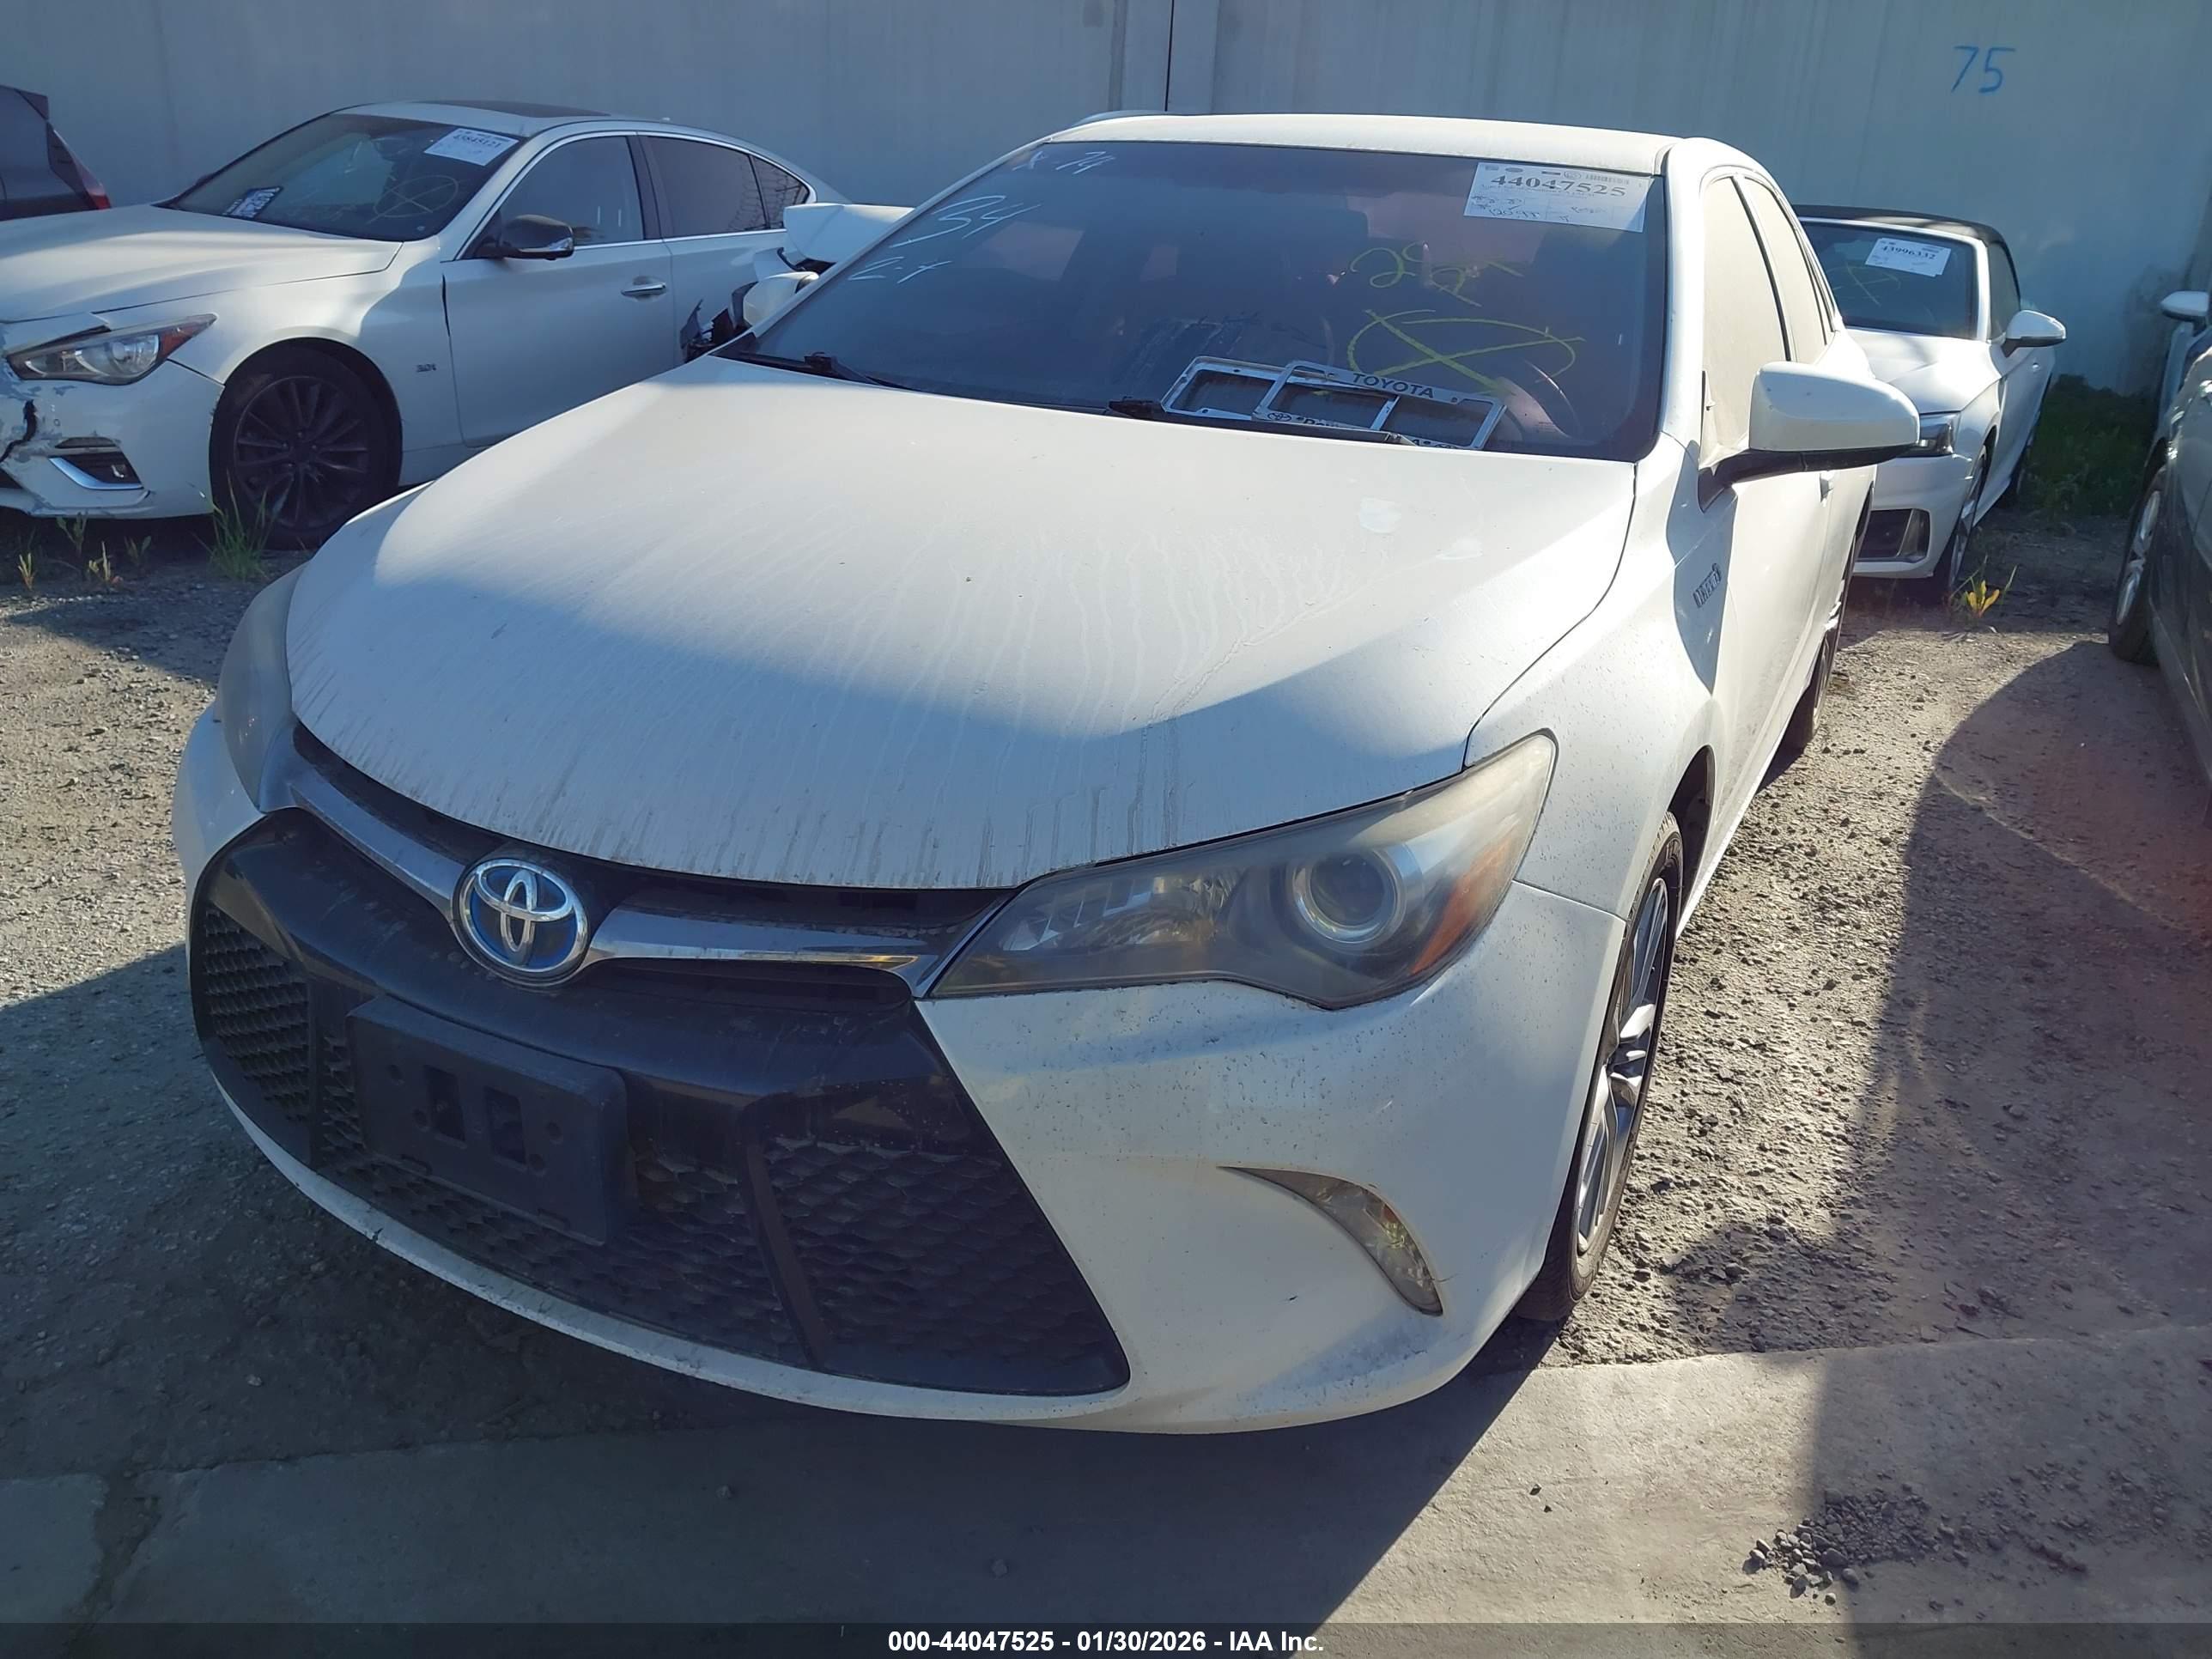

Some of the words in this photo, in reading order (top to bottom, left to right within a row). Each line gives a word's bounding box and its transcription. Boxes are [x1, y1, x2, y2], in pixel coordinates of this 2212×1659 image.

[1951, 46, 2016, 93] 75
[1491, 174, 1626, 197] 44047525
[1352, 372, 1434, 399] TOYOTA
